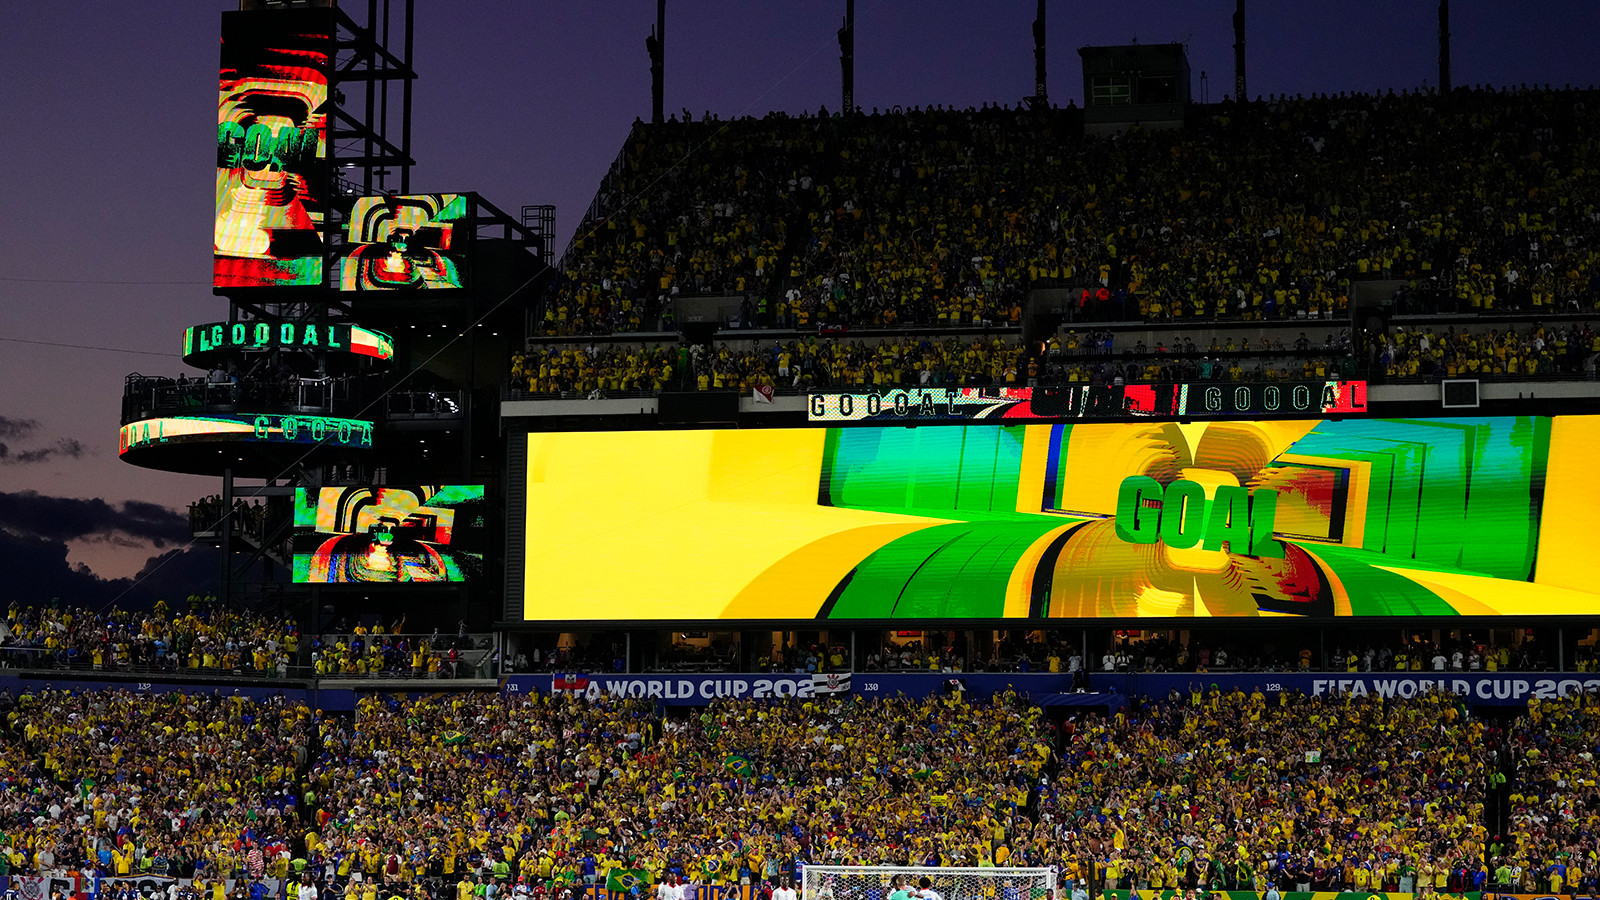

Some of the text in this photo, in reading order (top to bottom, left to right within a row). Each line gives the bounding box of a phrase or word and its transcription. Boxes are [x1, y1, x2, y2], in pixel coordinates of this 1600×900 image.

[811, 391, 963, 417] GOOOAL
[1205, 384, 1365, 412] GOOOAL
[1115, 475, 1287, 559] GOAL
[606, 679, 695, 699] WORLD
[699, 679, 748, 699] CUP
[753, 679, 816, 699] 202
[864, 682, 879, 691] 130
[1313, 679, 1368, 699] FIFA
[1476, 679, 1530, 699] CUP
